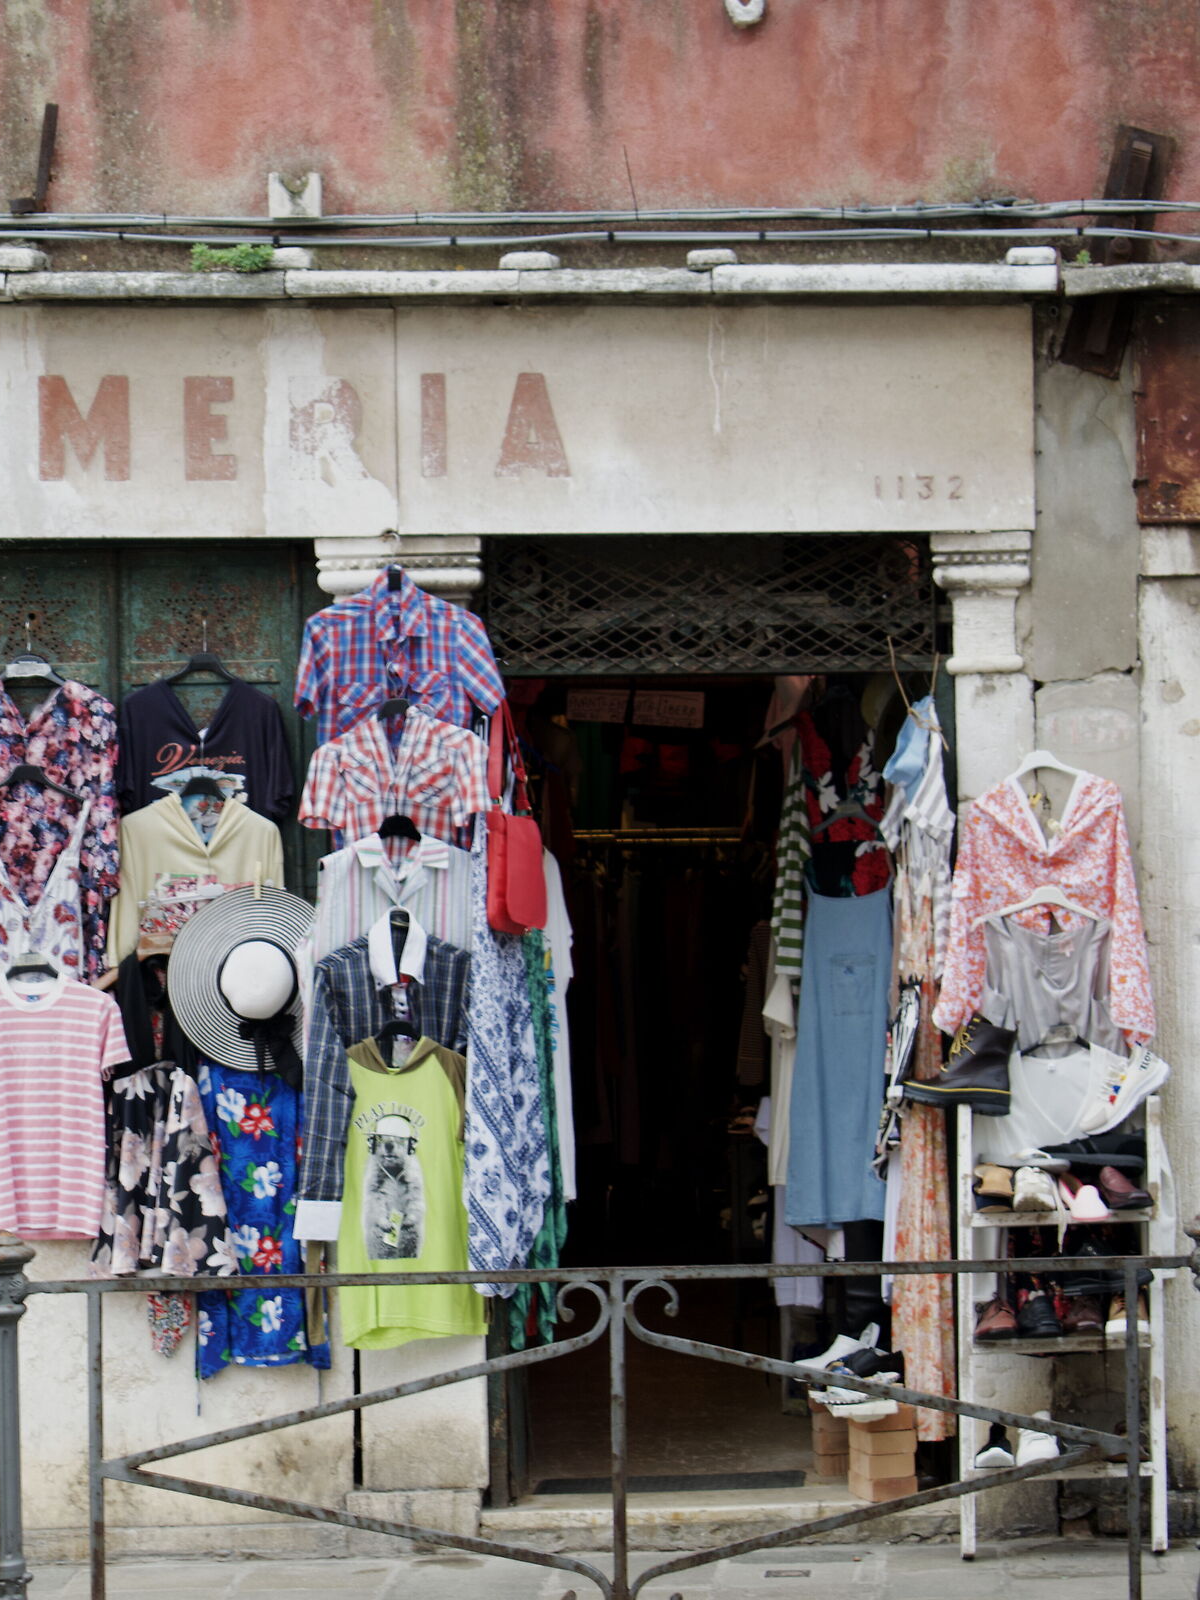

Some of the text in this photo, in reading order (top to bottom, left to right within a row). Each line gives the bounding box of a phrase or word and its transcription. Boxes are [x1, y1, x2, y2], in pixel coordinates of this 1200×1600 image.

[873, 474, 964, 500] 1132
[150, 742, 246, 776] Venezia
[353, 1102, 386, 1129] PLAY
